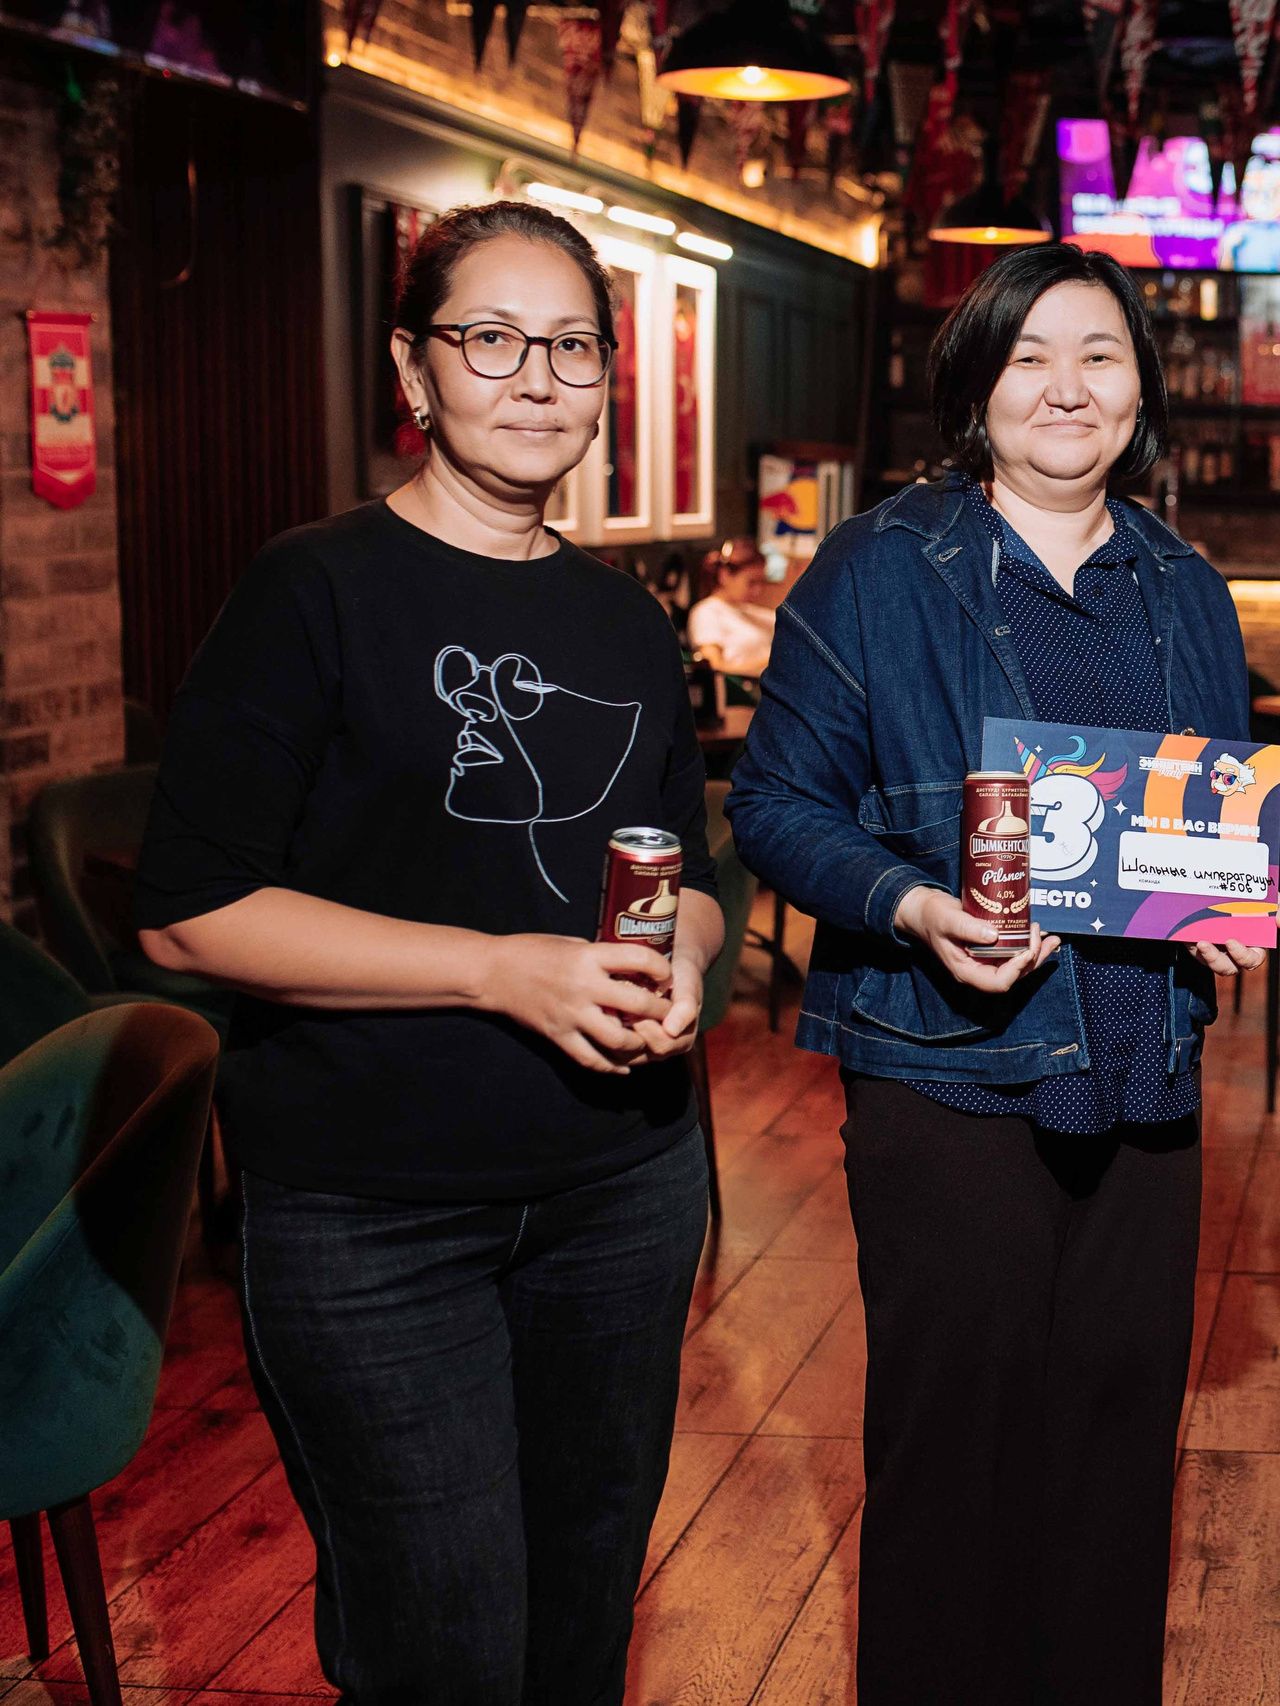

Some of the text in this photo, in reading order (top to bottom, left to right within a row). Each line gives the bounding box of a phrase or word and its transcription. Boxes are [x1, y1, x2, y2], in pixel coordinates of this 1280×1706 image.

[1030, 773, 1106, 882] 3
[1131, 814, 1157, 828] МЫ
[1160, 817, 1171, 829] В
[1173, 819, 1206, 833] ВАС
[972, 837, 1031, 855] ШЫМКЕНТСКО
[981, 867, 1027, 886] Pilsner
[1121, 856, 1188, 878] Шальные
[996, 890, 1016, 900] 4,0%
[1219, 882, 1253, 894] #506
